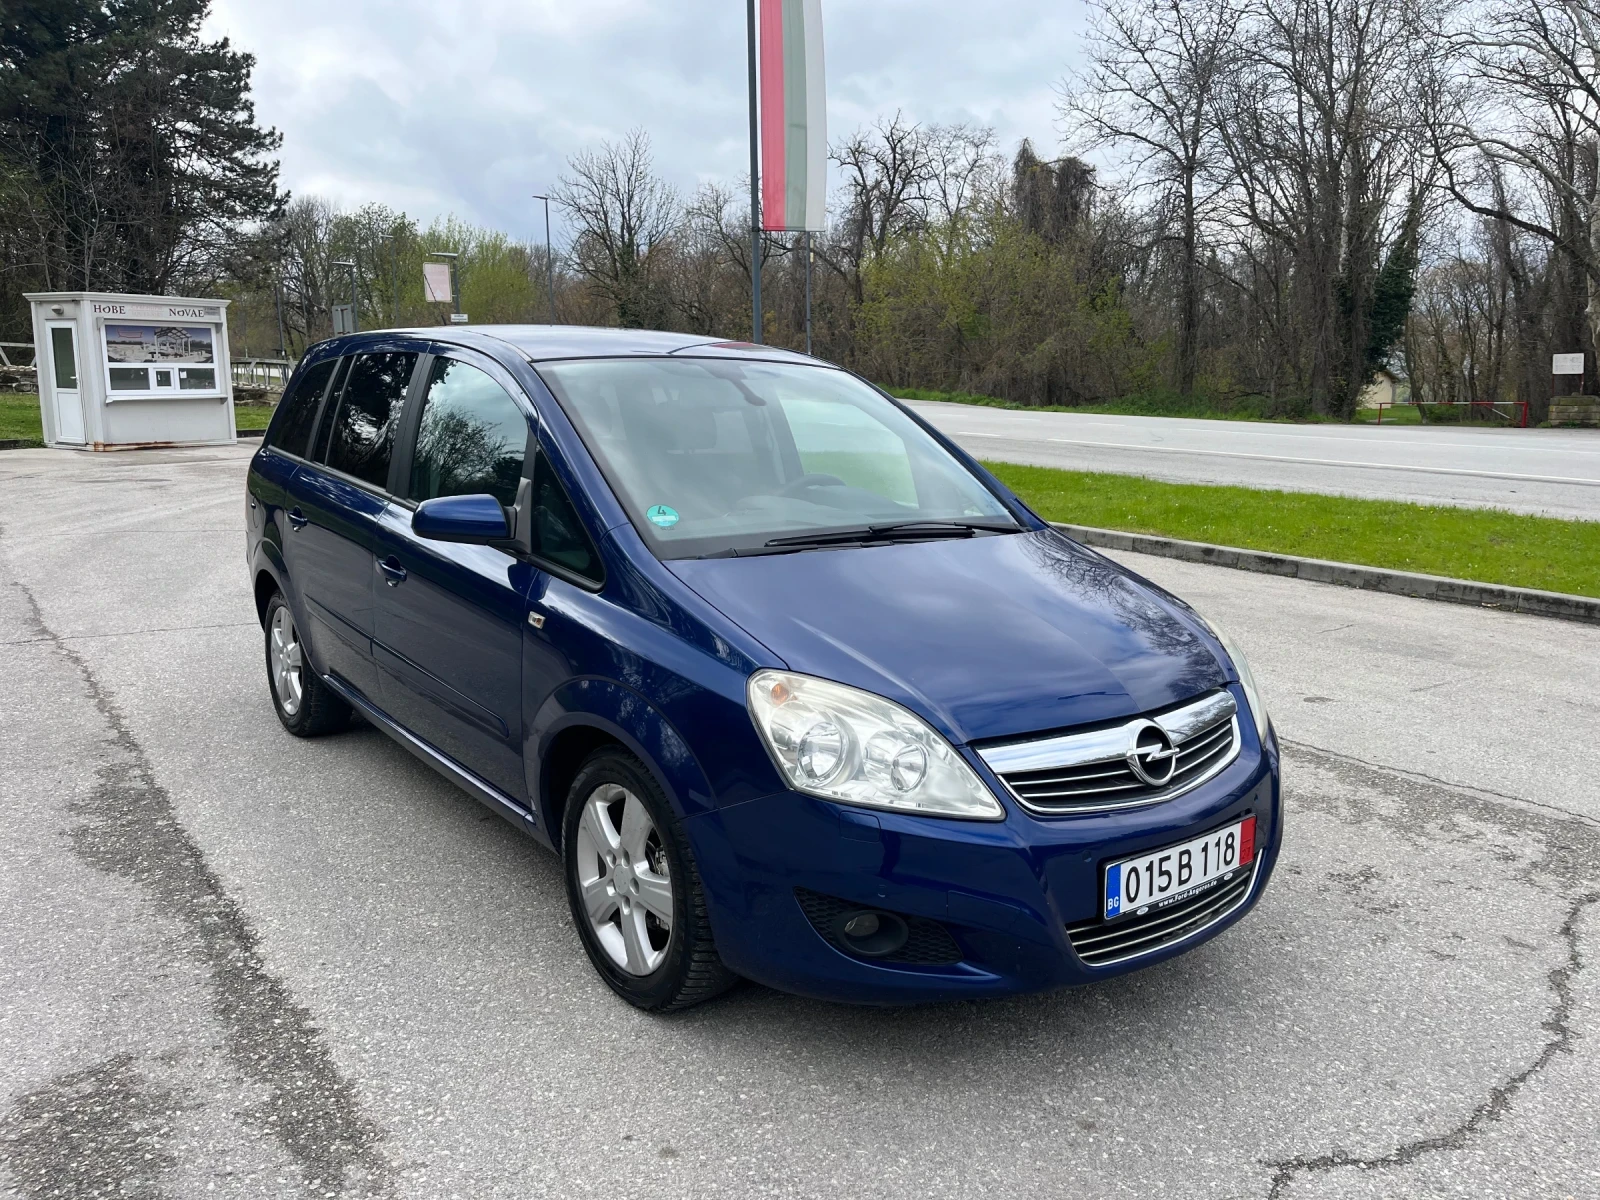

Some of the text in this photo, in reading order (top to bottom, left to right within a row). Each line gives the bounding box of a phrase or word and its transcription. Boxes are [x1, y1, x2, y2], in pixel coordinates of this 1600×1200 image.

[169, 308, 205, 318] NOVAE
[657, 506, 667, 516] 4
[1108, 897, 1120, 910] BG
